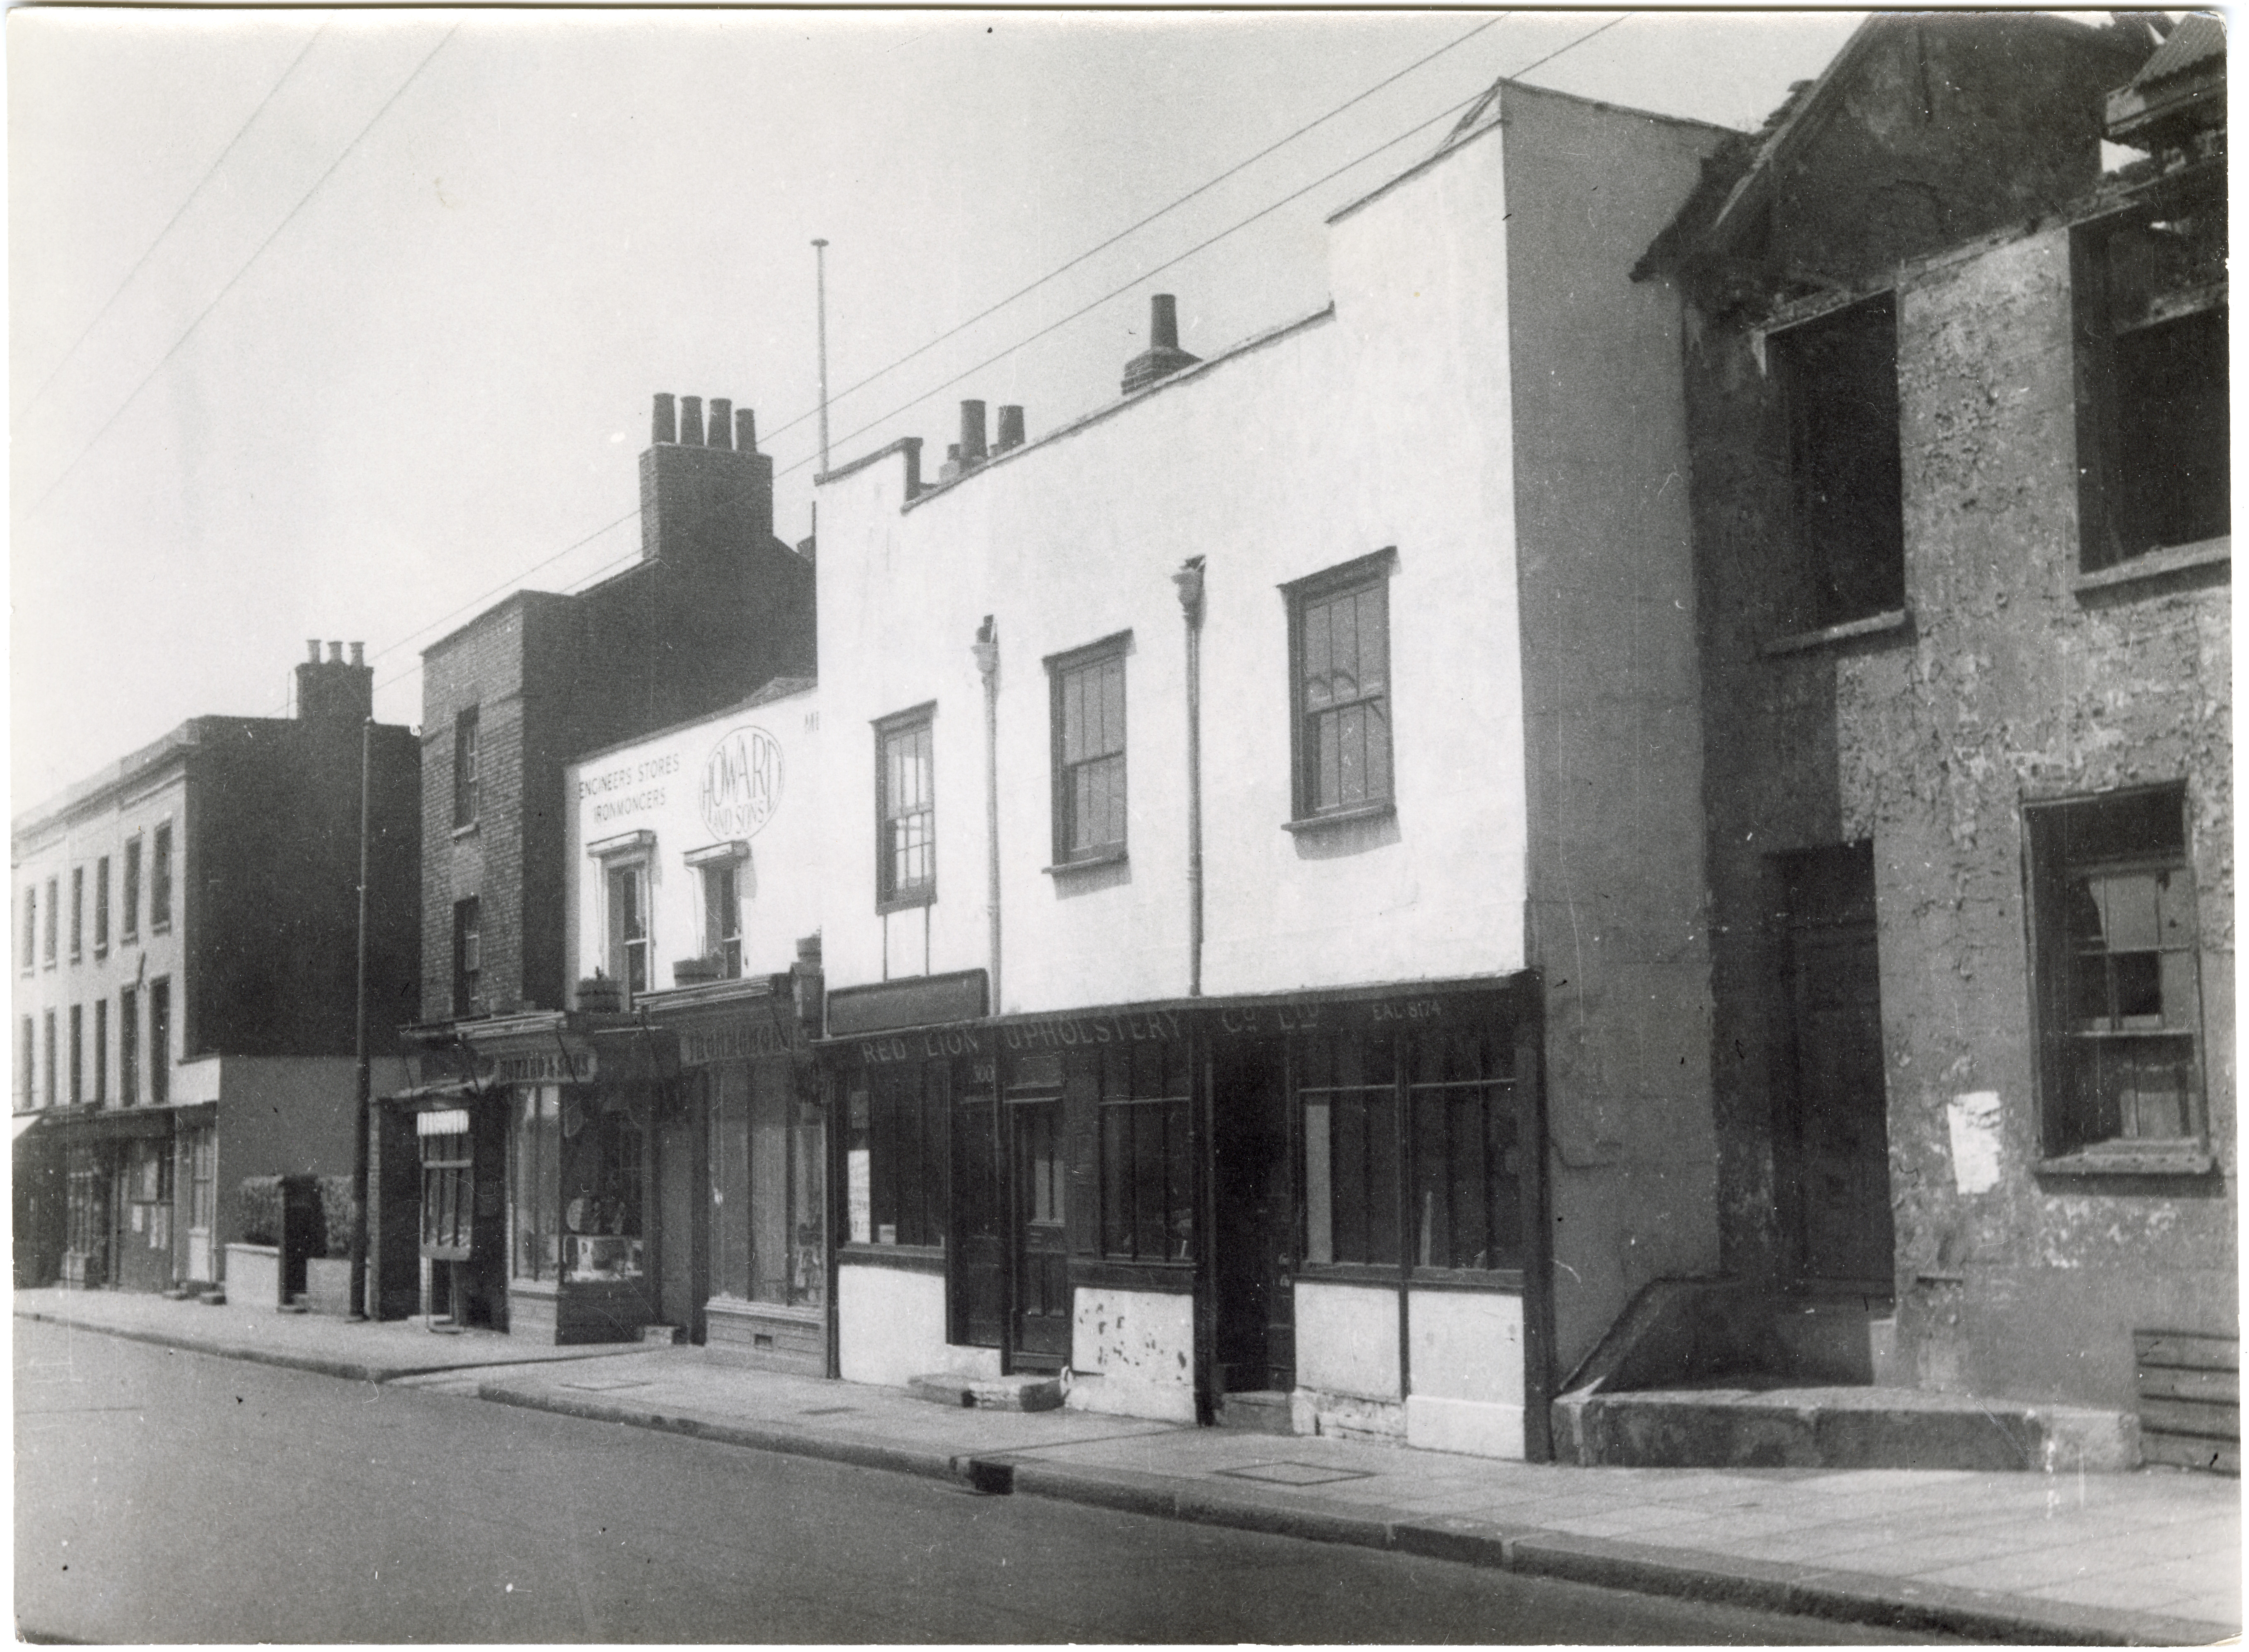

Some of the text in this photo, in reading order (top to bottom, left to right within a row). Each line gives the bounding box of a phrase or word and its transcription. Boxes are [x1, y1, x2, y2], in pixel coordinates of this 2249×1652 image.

[579, 753, 680, 799] ENGINEERS STORES
[702, 733, 782, 823] HOWARD
[713, 800, 764, 834] AND SONS
[1372, 1002, 1403, 1021] EAL
[861, 1037, 907, 1063] RED
[925, 1028, 979, 1057] LION
[1004, 1009, 1180, 1050] UPHOLSTERY
